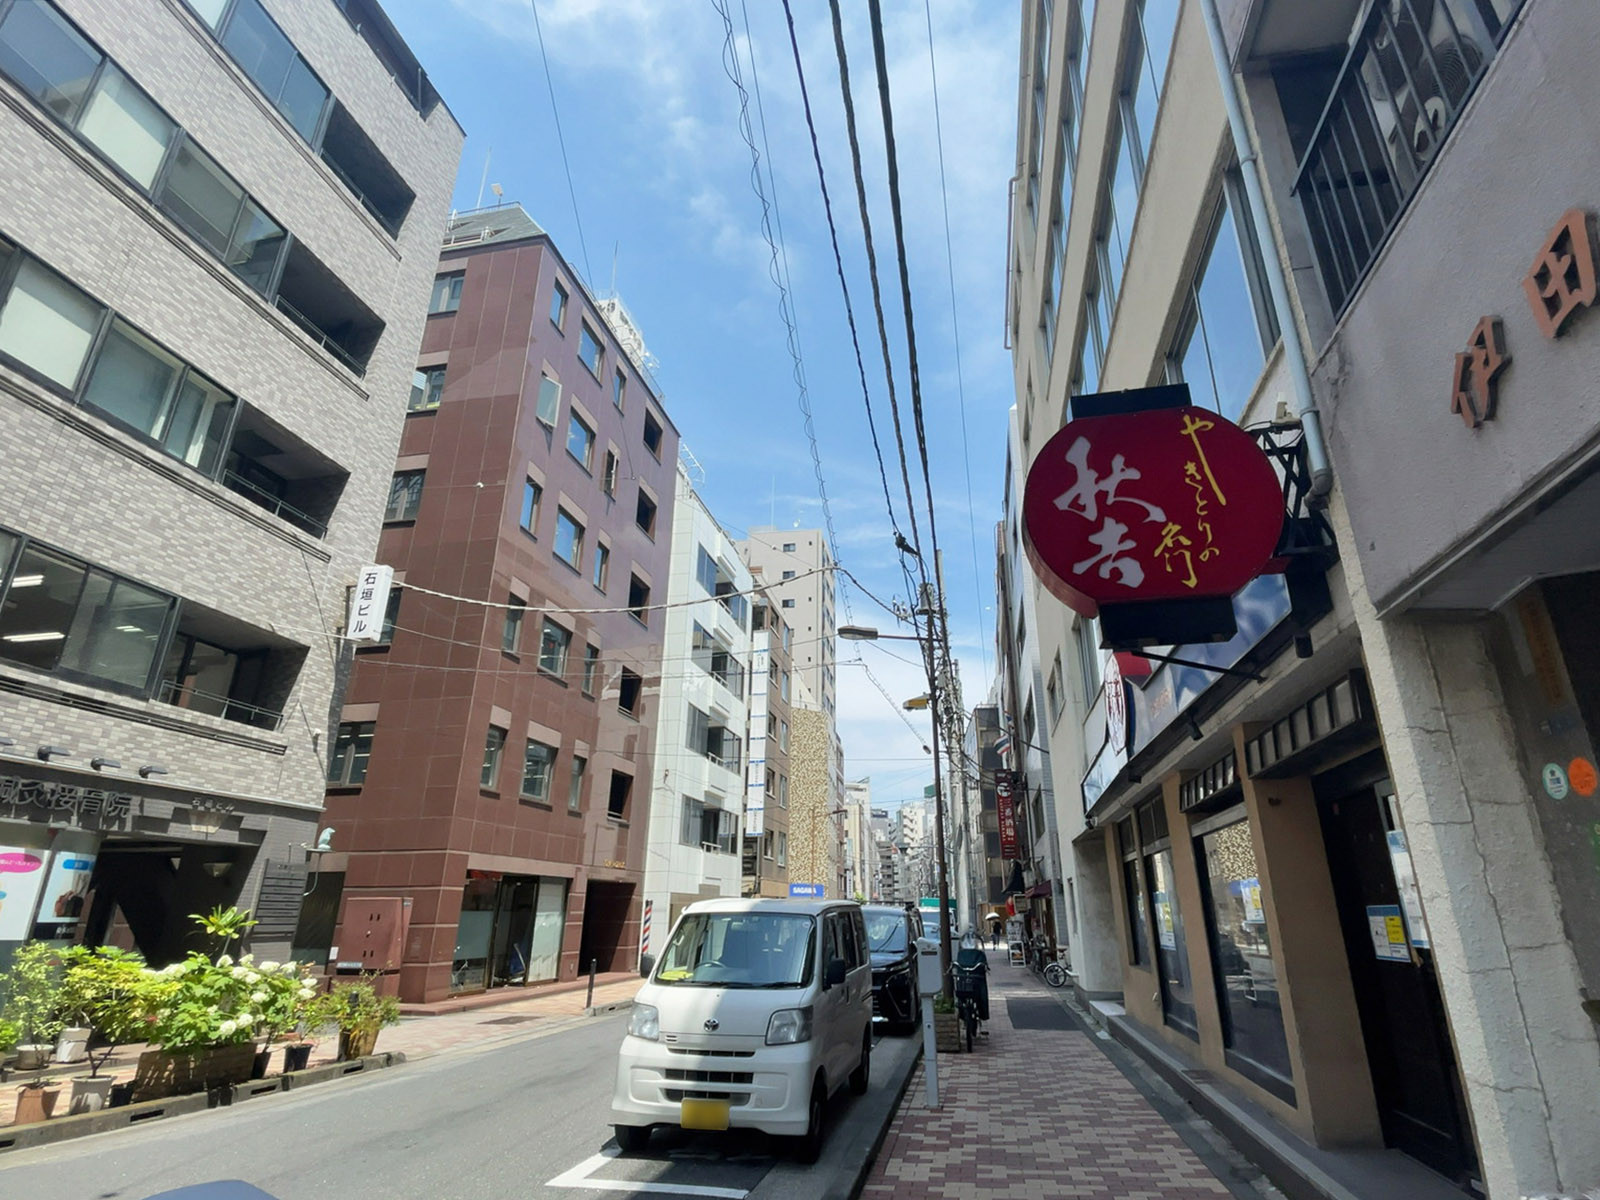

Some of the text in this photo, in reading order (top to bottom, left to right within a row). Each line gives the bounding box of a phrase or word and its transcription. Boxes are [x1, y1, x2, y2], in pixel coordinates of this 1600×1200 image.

[1053, 435, 1168, 589] 秋吉
[1179, 413, 1228, 563] やきとりの
[353, 572, 378, 633] 石垣ビル
